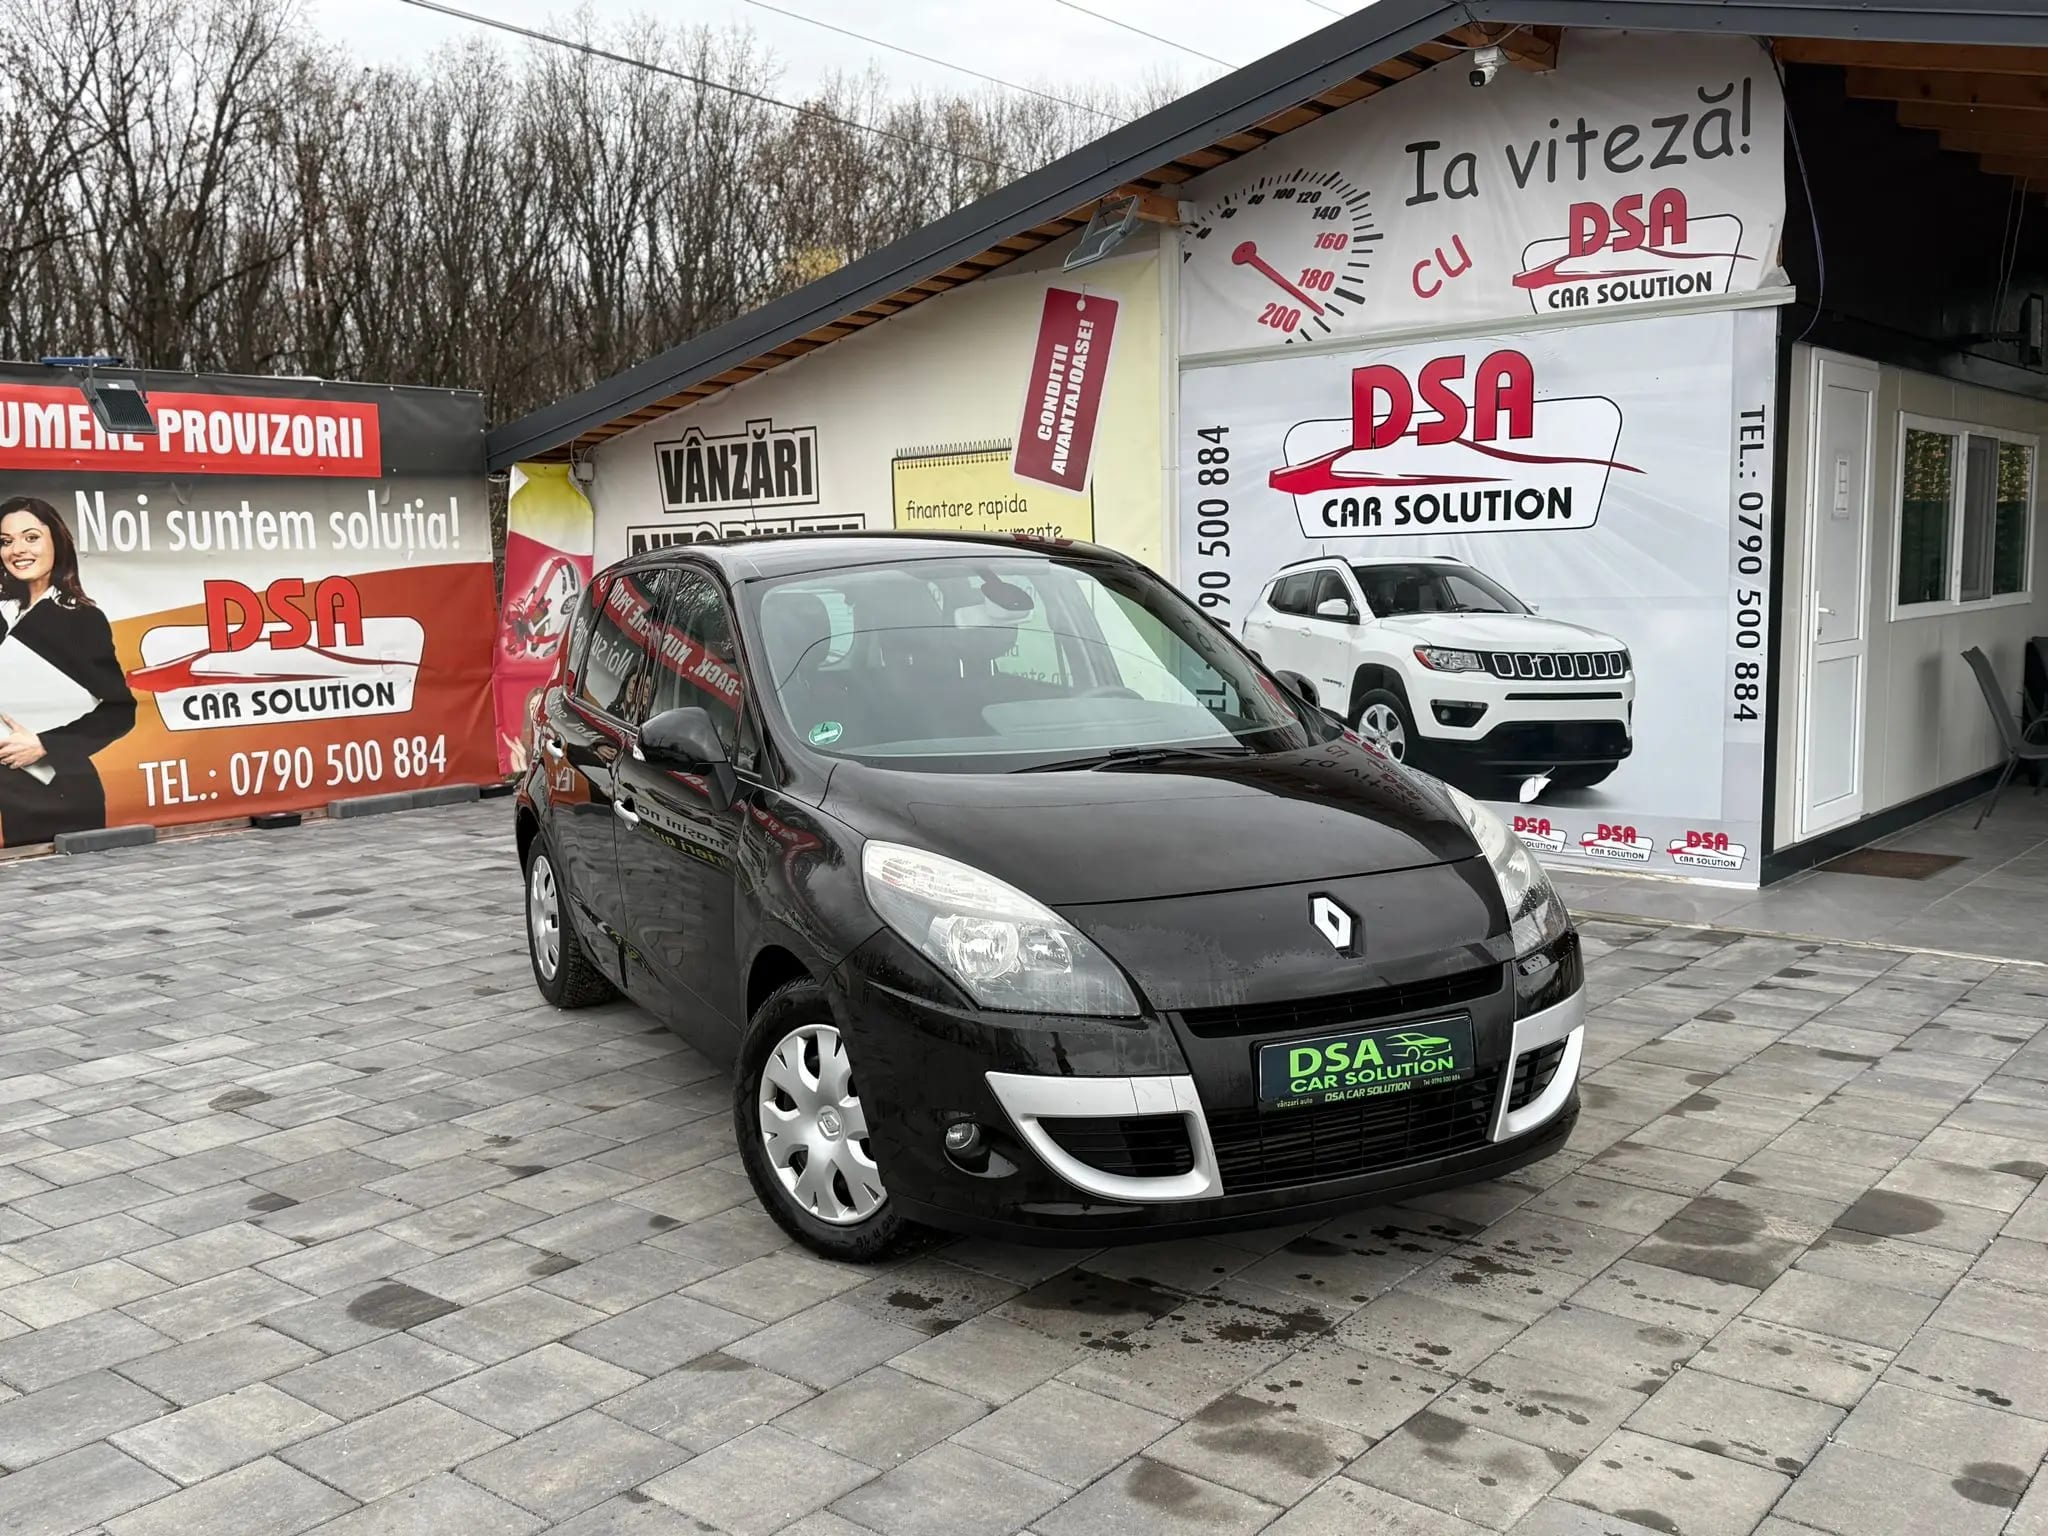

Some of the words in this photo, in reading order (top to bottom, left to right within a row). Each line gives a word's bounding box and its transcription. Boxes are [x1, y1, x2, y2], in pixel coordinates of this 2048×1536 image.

[1405, 138, 1478, 207] Ia
[1506, 76, 1752, 189] viteză!
[1272, 187, 1296, 200] 100
[1296, 190, 1322, 204] 120
[1312, 205, 1341, 221] 140
[1313, 231, 1349, 251] 160
[1568, 188, 1689, 258] DSA
[1298, 267, 1336, 292] 180
[1411, 233, 1473, 299] cu
[1547, 287, 1590, 310] CAR
[1596, 271, 1713, 305] SOLUTION
[1256, 301, 1302, 334] 200
[1037, 343, 1069, 441] CONDITII
[1051, 318, 1095, 477] AVANTAJOASE!
[1351, 350, 1534, 450] DSA
[157, 408, 364, 459] PROVIZORII
[1738, 403, 1766, 480] TEL.:
[660, 428, 813, 505] VÂNZĂRI
[1197, 425, 1230, 486] 884
[75, 490, 151, 552] Noi
[166, 500, 317, 551] suntem
[329, 489, 461, 562] soluția!
[906, 500, 974, 520] finantare
[978, 493, 1029, 520] rapida
[1322, 492, 1382, 528] CAR
[1394, 486, 1573, 527] SOLUTION
[1197, 499, 1231, 558] 500
[1737, 492, 1765, 575] 0790
[204, 576, 363, 653] DSA
[1736, 588, 1762, 650] 500
[182, 691, 241, 721] CAR
[252, 681, 395, 714] SOLUTION
[1733, 661, 1760, 723] 884
[139, 760, 219, 807] TEL.:
[229, 748, 313, 797] 0790
[326, 742, 383, 786] 500
[393, 734, 447, 777] 884
[1514, 816, 1551, 836] DSA
[1598, 823, 1636, 844] DSA
[1687, 831, 1729, 851] DSA
[1607, 849, 1644, 860] SOLUTION
[1697, 857, 1737, 868] SOLUTION
[1290, 1039, 1384, 1079] DSA
[1290, 1076, 1338, 1093] CAR
[1345, 1056, 1454, 1086] SOLUTION
[1325, 1092, 1345, 1103] DSA
[1346, 1088, 1365, 1099] CAR
[1367, 1081, 1411, 1097] SOLUTION
